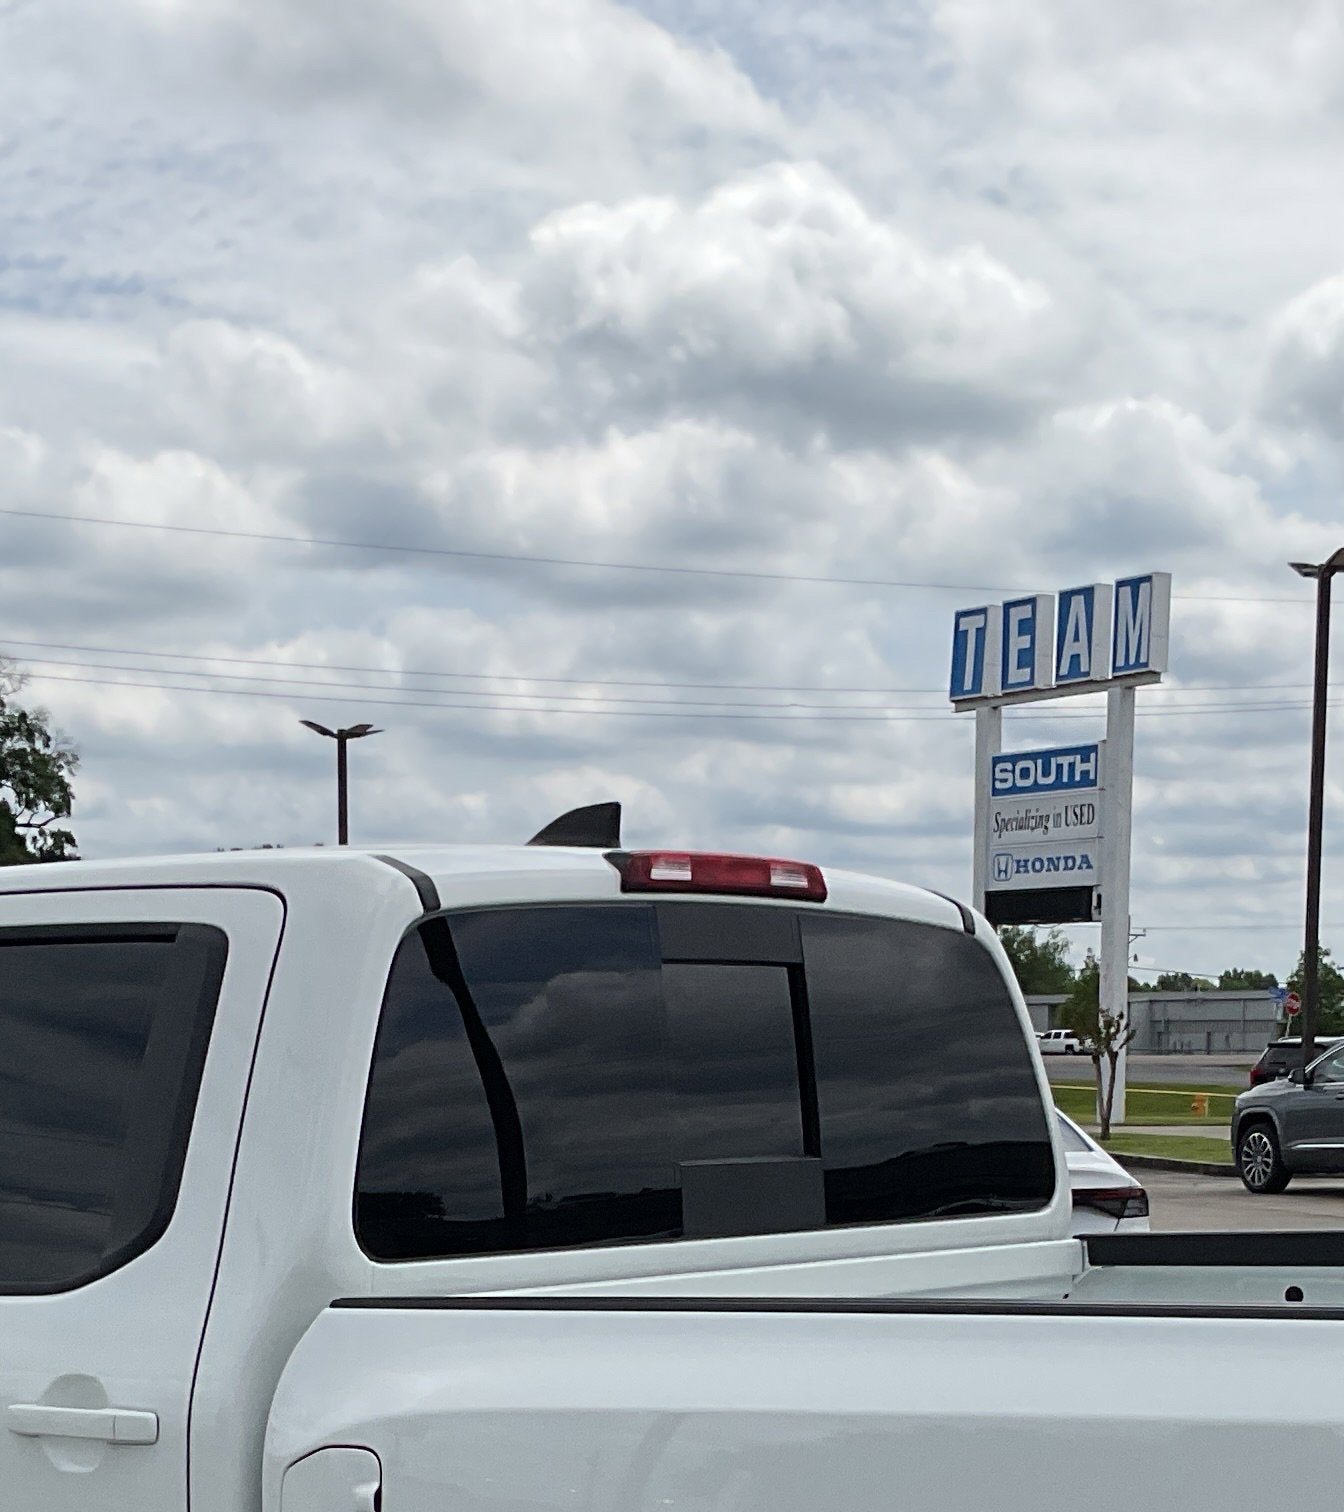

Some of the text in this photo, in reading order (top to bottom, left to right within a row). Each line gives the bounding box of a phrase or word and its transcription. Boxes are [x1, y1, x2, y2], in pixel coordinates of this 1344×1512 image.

[958, 582, 1152, 691] TEAM
[994, 752, 1096, 789] SOUTH
[993, 803, 1095, 839] Specializing in USED
[1014, 854, 1094, 874] HONDA
